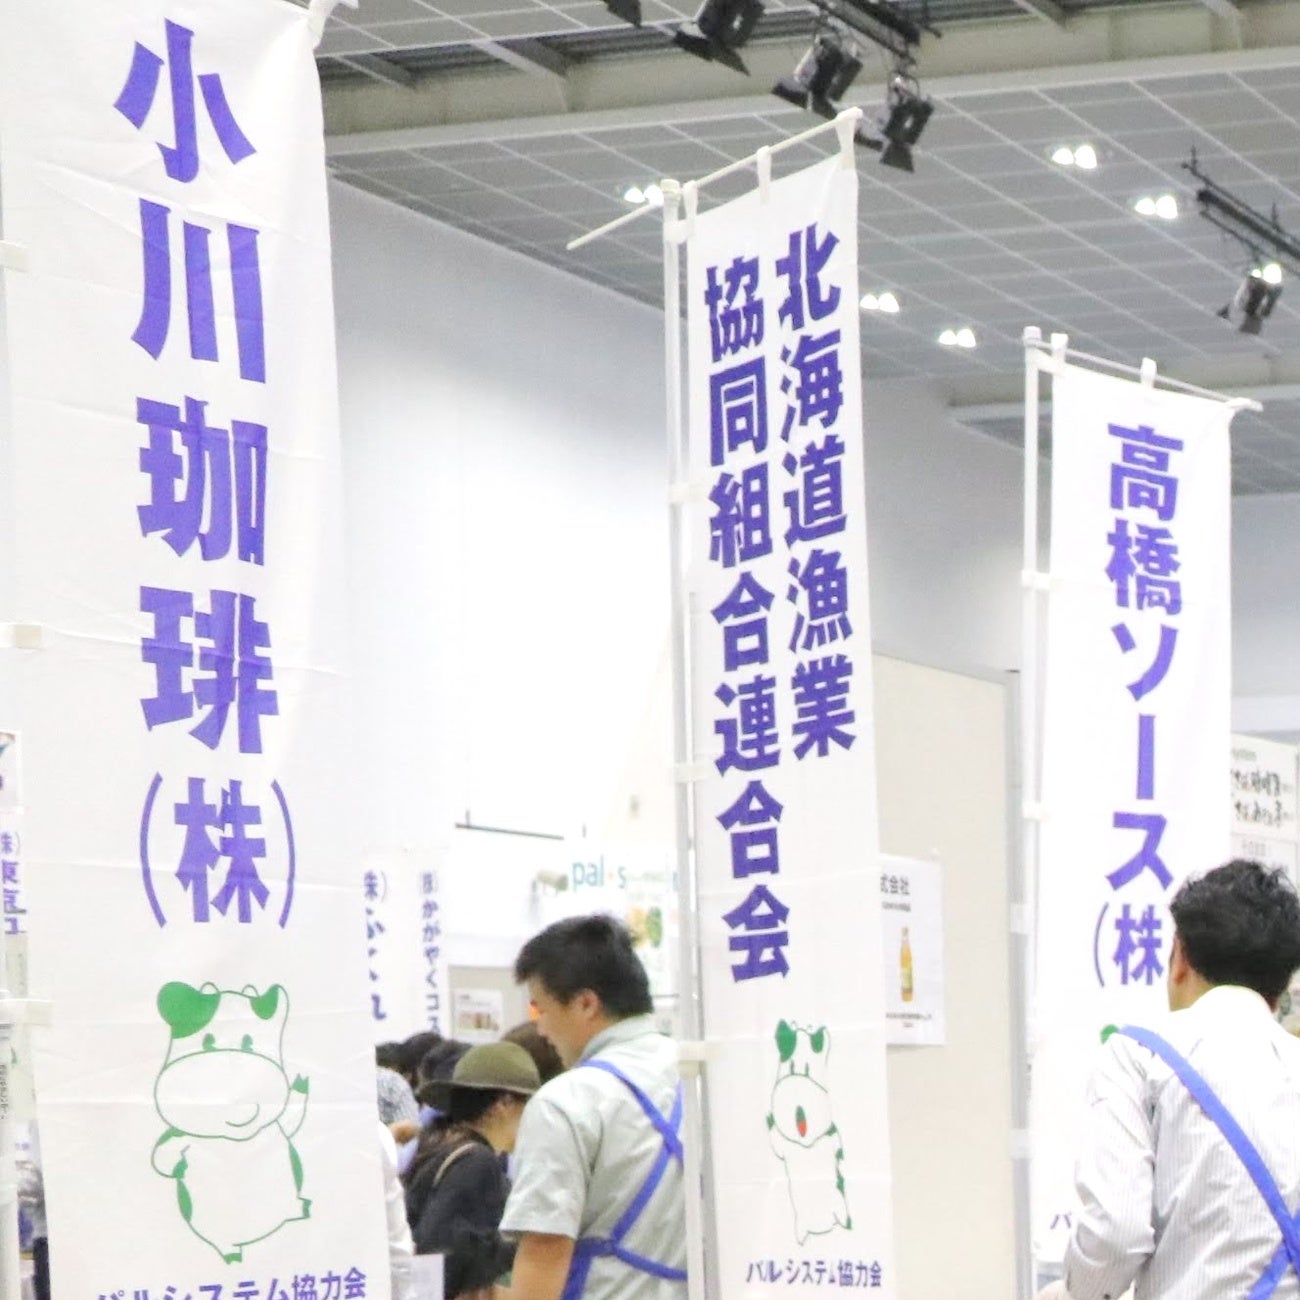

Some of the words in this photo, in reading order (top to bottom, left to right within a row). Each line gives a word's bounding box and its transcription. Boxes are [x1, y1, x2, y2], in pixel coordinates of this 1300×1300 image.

[704, 256, 791, 983] 協同組合連合会
[775, 223, 856, 761] 北海道漁業
